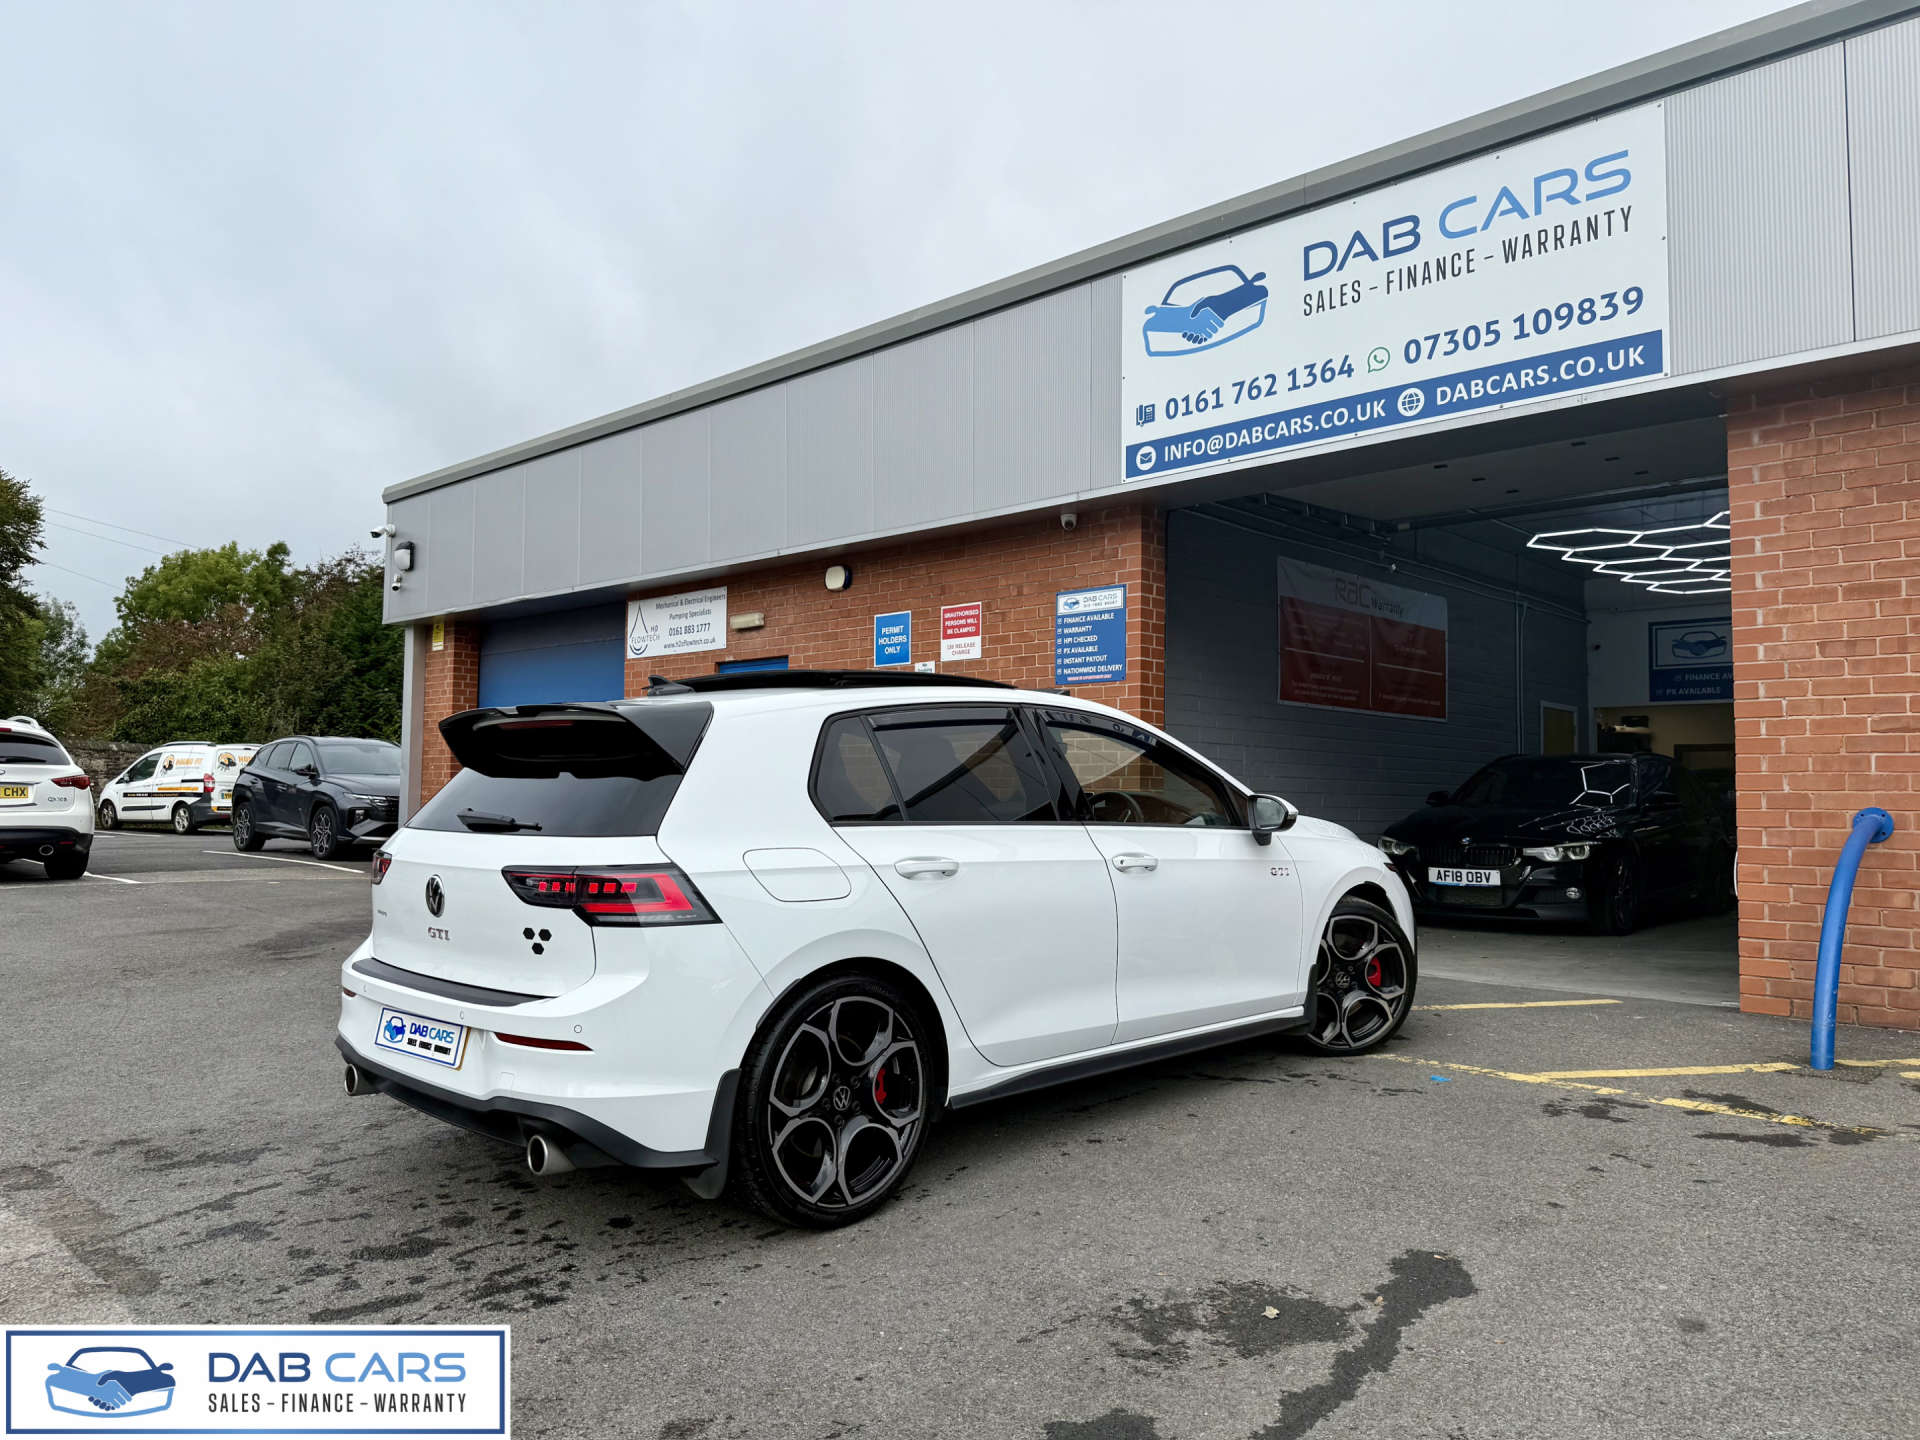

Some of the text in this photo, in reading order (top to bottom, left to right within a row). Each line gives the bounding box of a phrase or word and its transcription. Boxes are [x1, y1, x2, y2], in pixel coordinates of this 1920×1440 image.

[1303, 150, 1632, 281] DAB CARS
[1303, 280, 1362, 317] SALES
[1386, 248, 1476, 295] FINANCE
[1502, 205, 1632, 264] WARRANTY
[1403, 286, 1644, 364] 07305 109839
[1436, 345, 1645, 406] DABCARS.CO.UK
[1165, 354, 1354, 420] 0161 762 1364
[1164, 399, 1386, 462] INFO@DABCARS.CO.UK
[1063, 612, 1115, 624] FINANCE AVAILABLE
[669, 625, 683, 637] 0161
[696, 622, 711, 633] 1777
[881, 625, 904, 635] PERMIT
[1063, 625, 1092, 634] WARRANTY
[878, 635, 907, 645] HOLDERS
[1073, 635, 1098, 643] CHECKED
[884, 645, 901, 655] ONLY
[1071, 645, 1098, 653] AVAILABLE
[1063, 654, 1107, 664] INSTANT PAYOUT
[1063, 664, 1123, 675] NATIONWIDE DELIVERY
[3, 787, 26, 797] CHX
[1436, 869, 1491, 883] AF18 OBV
[428, 926, 450, 941] GTI
[409, 1022, 455, 1044] DAB CARS
